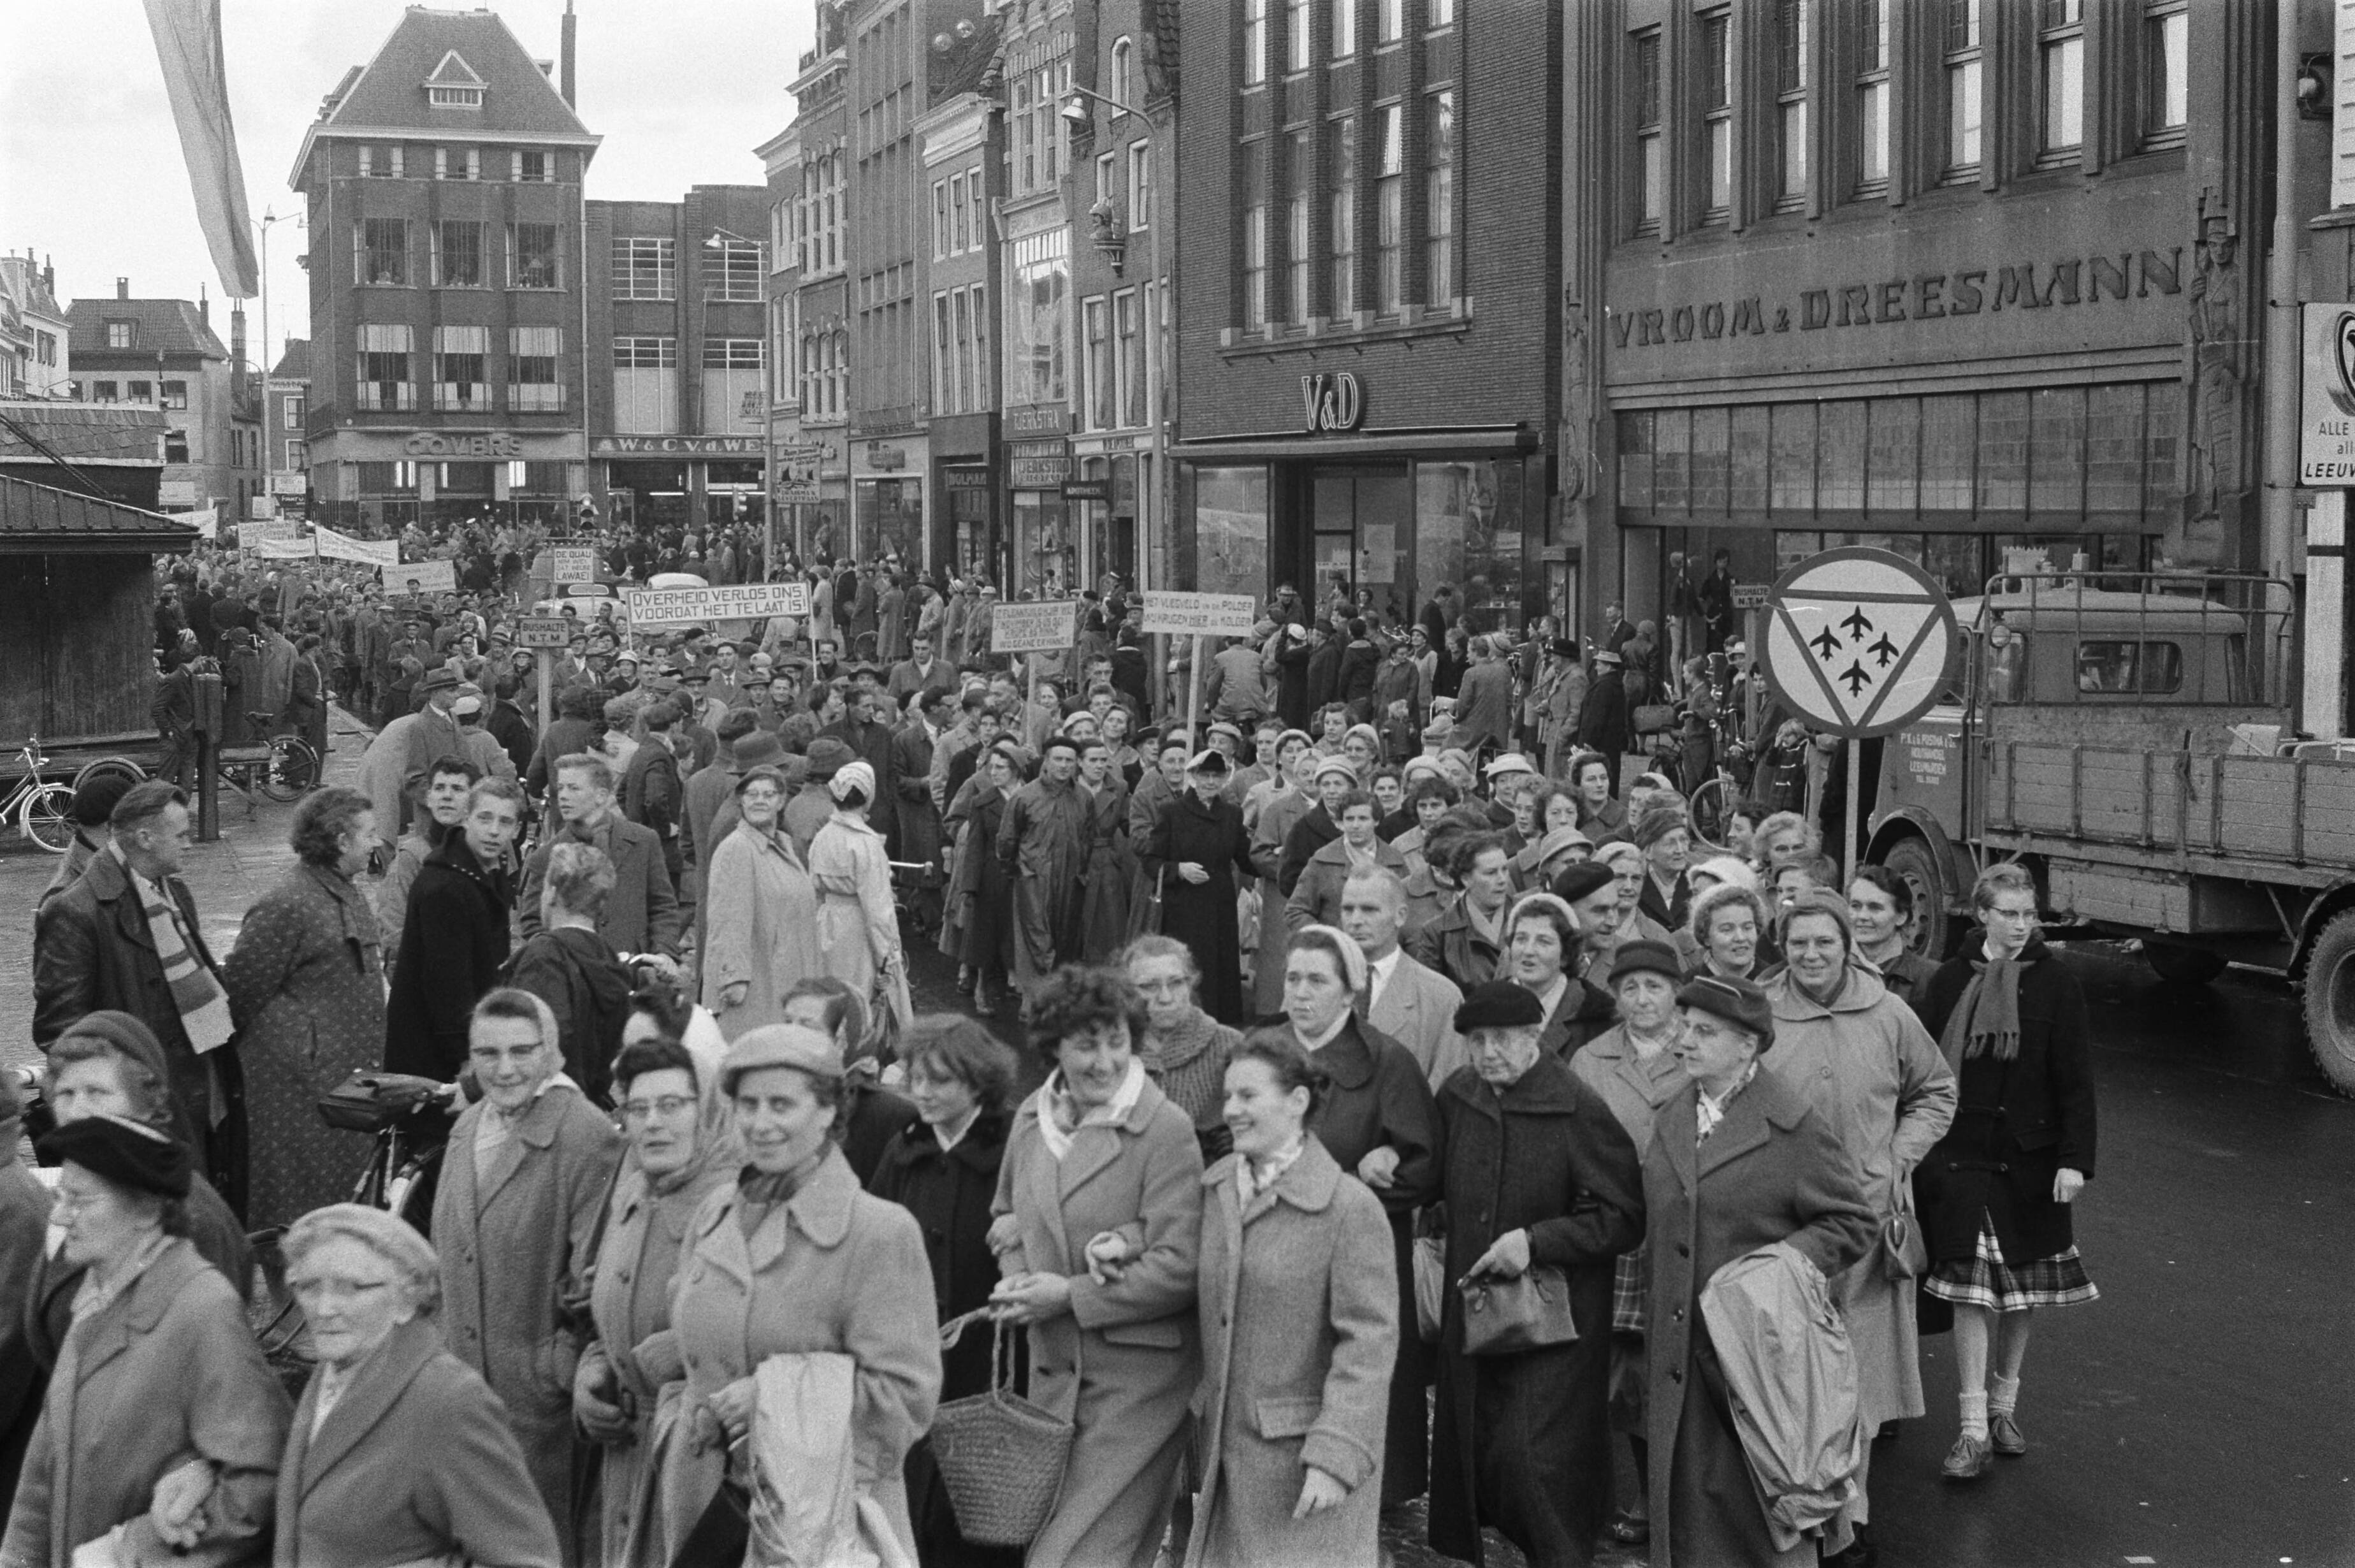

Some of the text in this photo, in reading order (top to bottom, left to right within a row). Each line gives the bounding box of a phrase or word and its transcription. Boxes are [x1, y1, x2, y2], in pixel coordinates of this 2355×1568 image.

[1609, 247, 2183, 348] VROOM & DREESMANN
[1301, 372, 1360, 431] V&D
[2319, 422, 2349, 435] ALLE
[723, 439, 766, 452] WE
[2337, 440, 2355, 454] all
[633, 590, 708, 606] OVERHEID
[712, 588, 767, 602] VERLOS
[634, 606, 699, 620] VOORDAT
[704, 604, 730, 616] HET
[735, 603, 753, 614] TE
[755, 600, 785, 614] LAAT
[1222, 600, 1252, 611] POLDER
[523, 623, 566, 632] BUSHALTE
